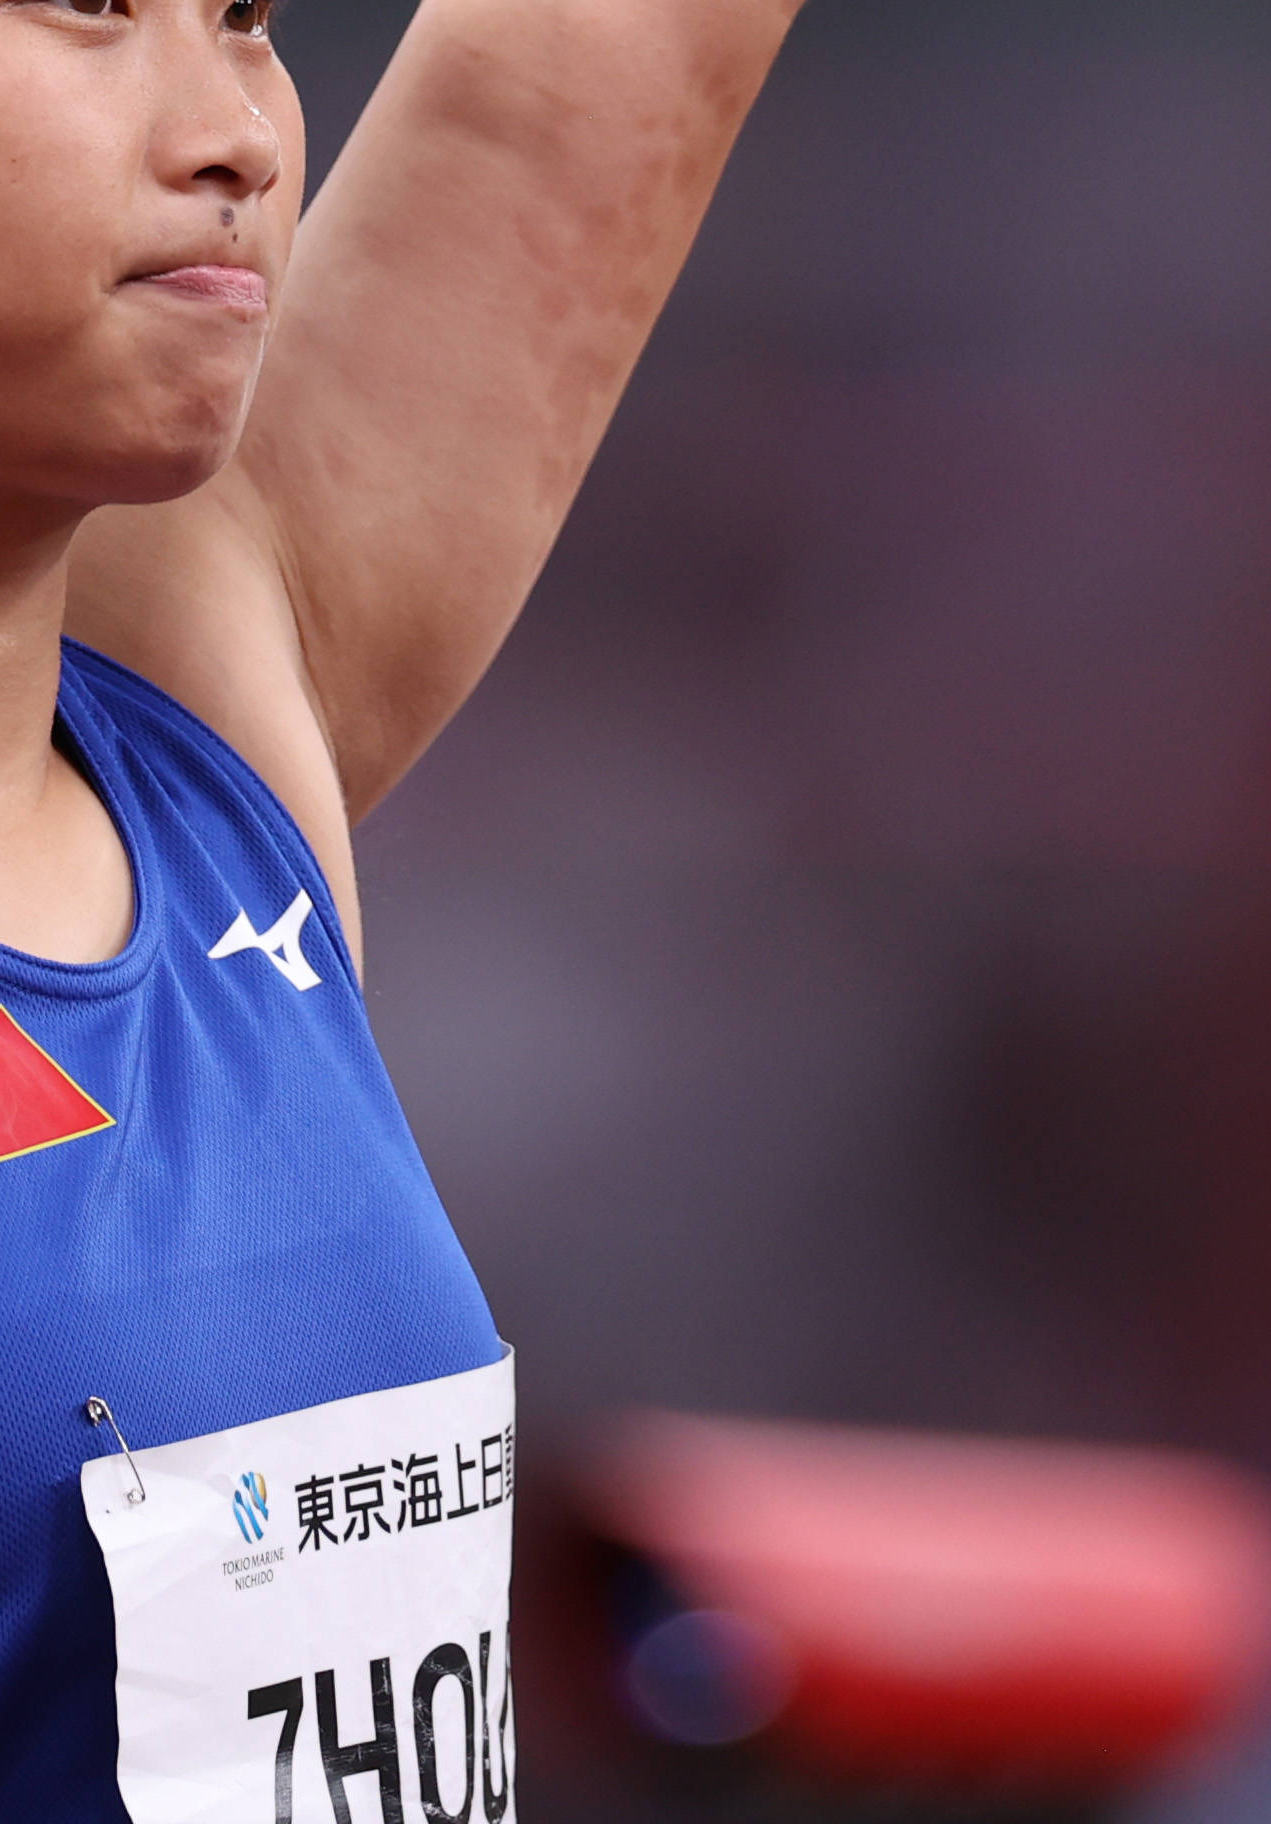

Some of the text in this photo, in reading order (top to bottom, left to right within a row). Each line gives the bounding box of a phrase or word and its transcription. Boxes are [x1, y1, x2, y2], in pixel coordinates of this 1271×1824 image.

[222, 1547, 284, 1576] TOKIO MARINE
[235, 1569, 274, 1592] NICHIDO
